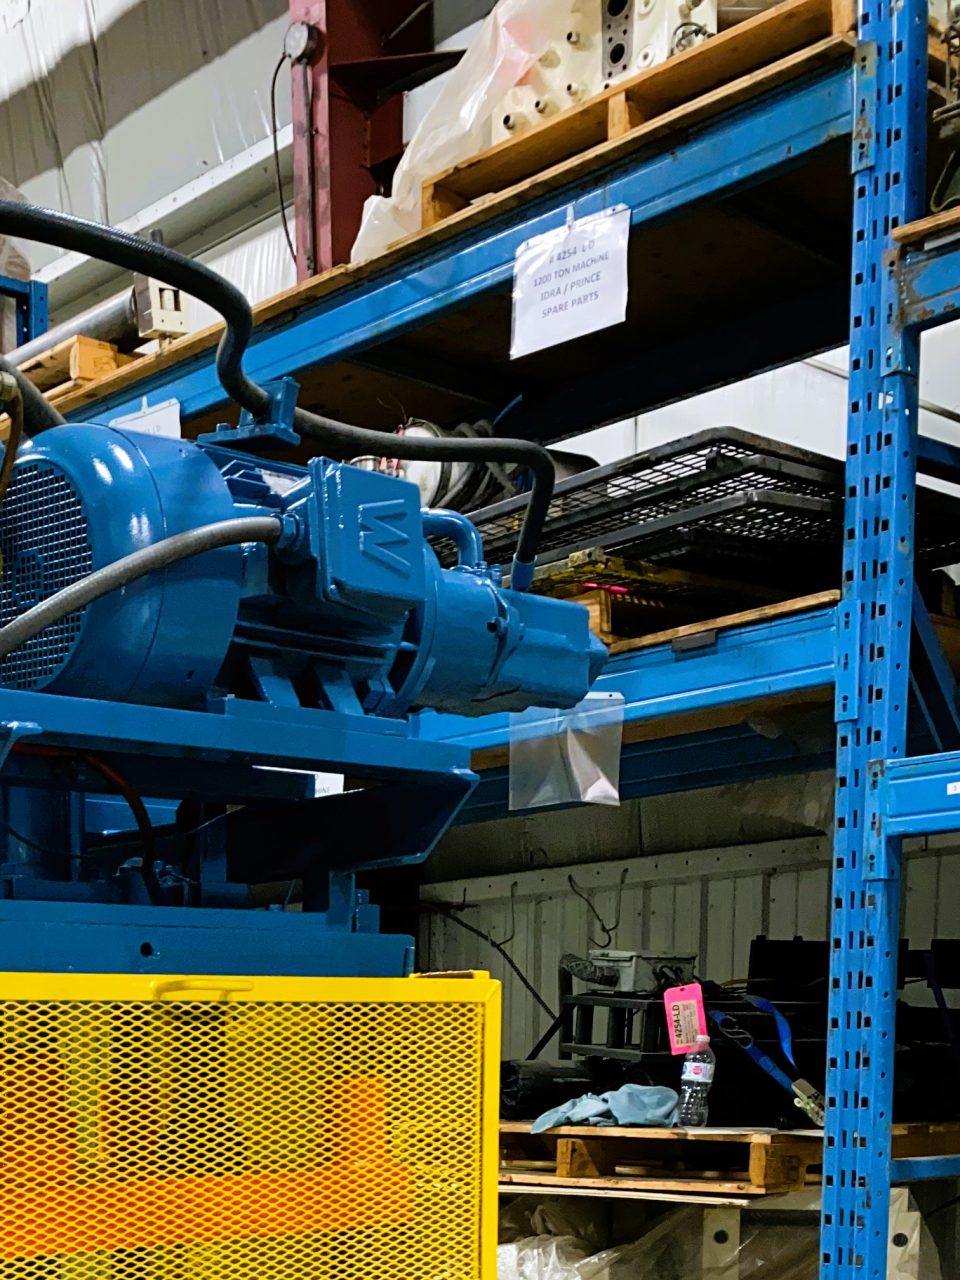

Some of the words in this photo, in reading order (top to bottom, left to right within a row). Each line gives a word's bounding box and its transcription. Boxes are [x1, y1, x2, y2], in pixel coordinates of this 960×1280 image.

[533, 273, 552, 287] 1200
[554, 267, 570, 279] TON
[572, 251, 609, 273] MACHINE
[556, 246, 577, 261] 4254
[540, 287, 562, 302] IDRA
[570, 271, 601, 291] PRINCE
[541, 301, 569, 319] SPARE
[571, 290, 600, 308] PARTS
[357, 498, 412, 580] W
[672, 1004, 683, 1037] 4254-LD
